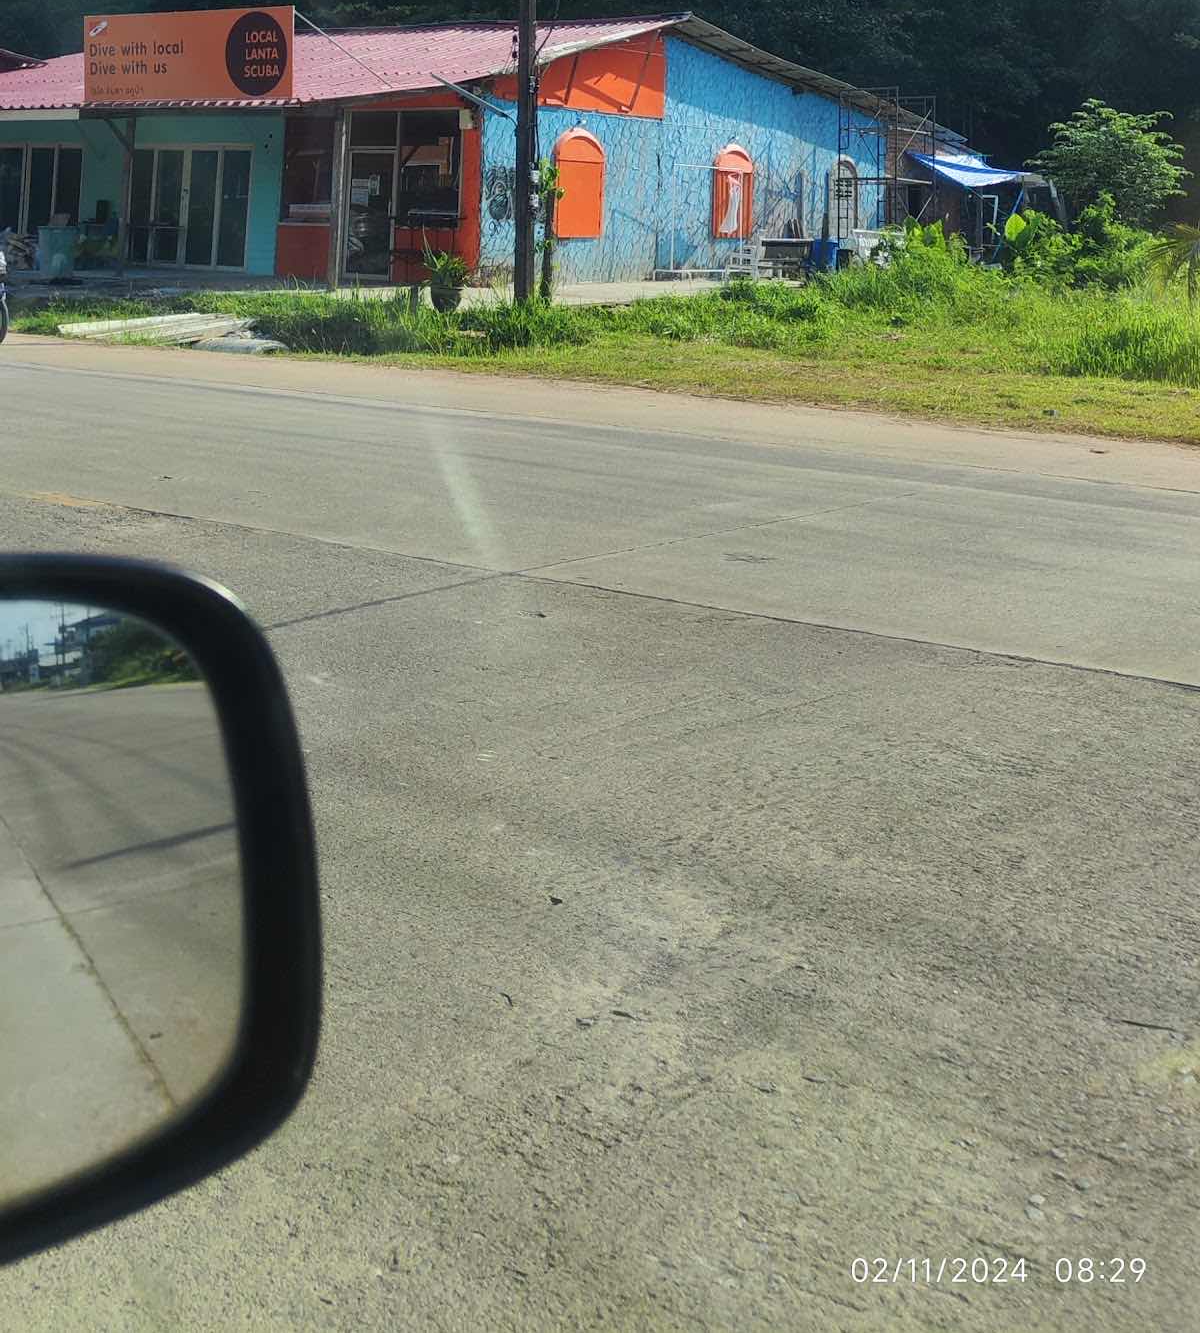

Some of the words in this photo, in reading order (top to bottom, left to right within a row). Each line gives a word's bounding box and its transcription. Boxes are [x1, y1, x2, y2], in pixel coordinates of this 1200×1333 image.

[245, 31, 279, 43] LOCAL
[89, 43, 116, 57] Dive
[121, 41, 147, 55] with
[153, 39, 184, 55] local
[245, 47, 279, 60] LANTA
[89, 62, 116, 76] Dive
[121, 60, 148, 75] with
[153, 63, 168, 74] us
[244, 64, 280, 78] SCUBA
